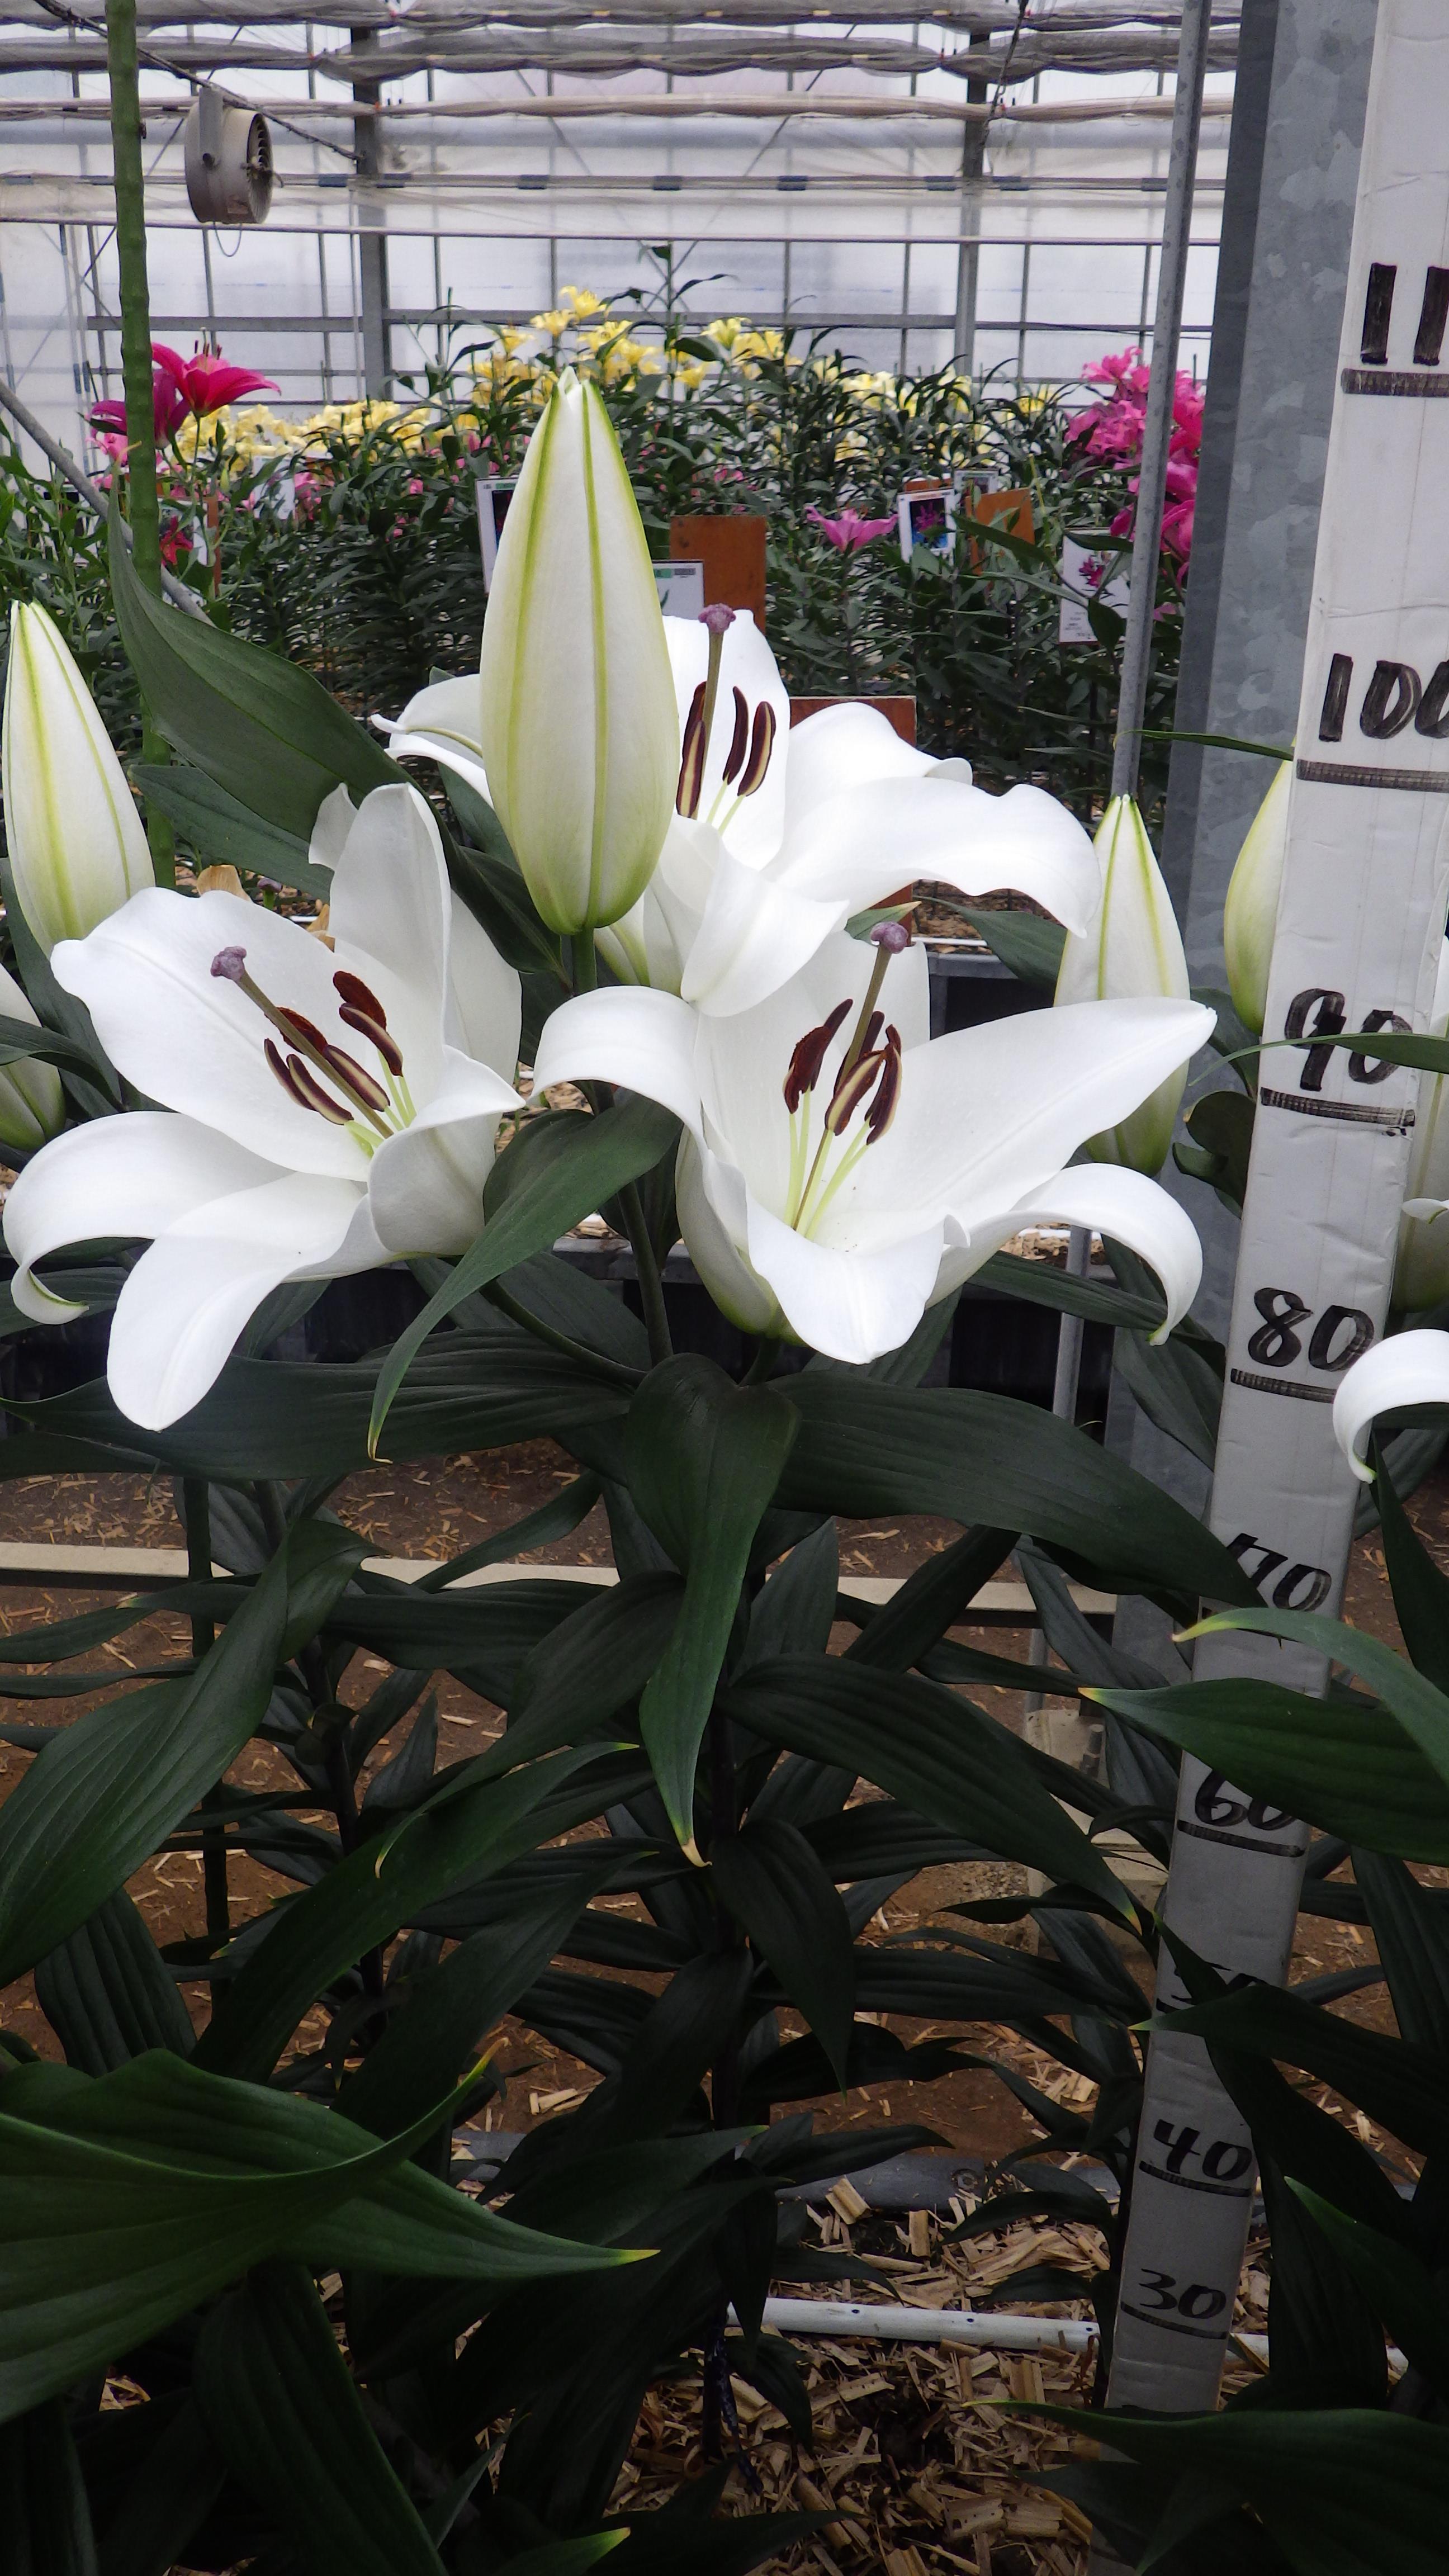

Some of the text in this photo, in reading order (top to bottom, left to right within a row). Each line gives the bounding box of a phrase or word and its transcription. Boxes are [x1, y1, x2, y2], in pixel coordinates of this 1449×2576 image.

[1284, 988, 1413, 1091] 90
[1248, 1287, 1374, 1372] 80
[1153, 2119, 1252, 2181] 40
[1139, 2268, 1227, 2319] 30
